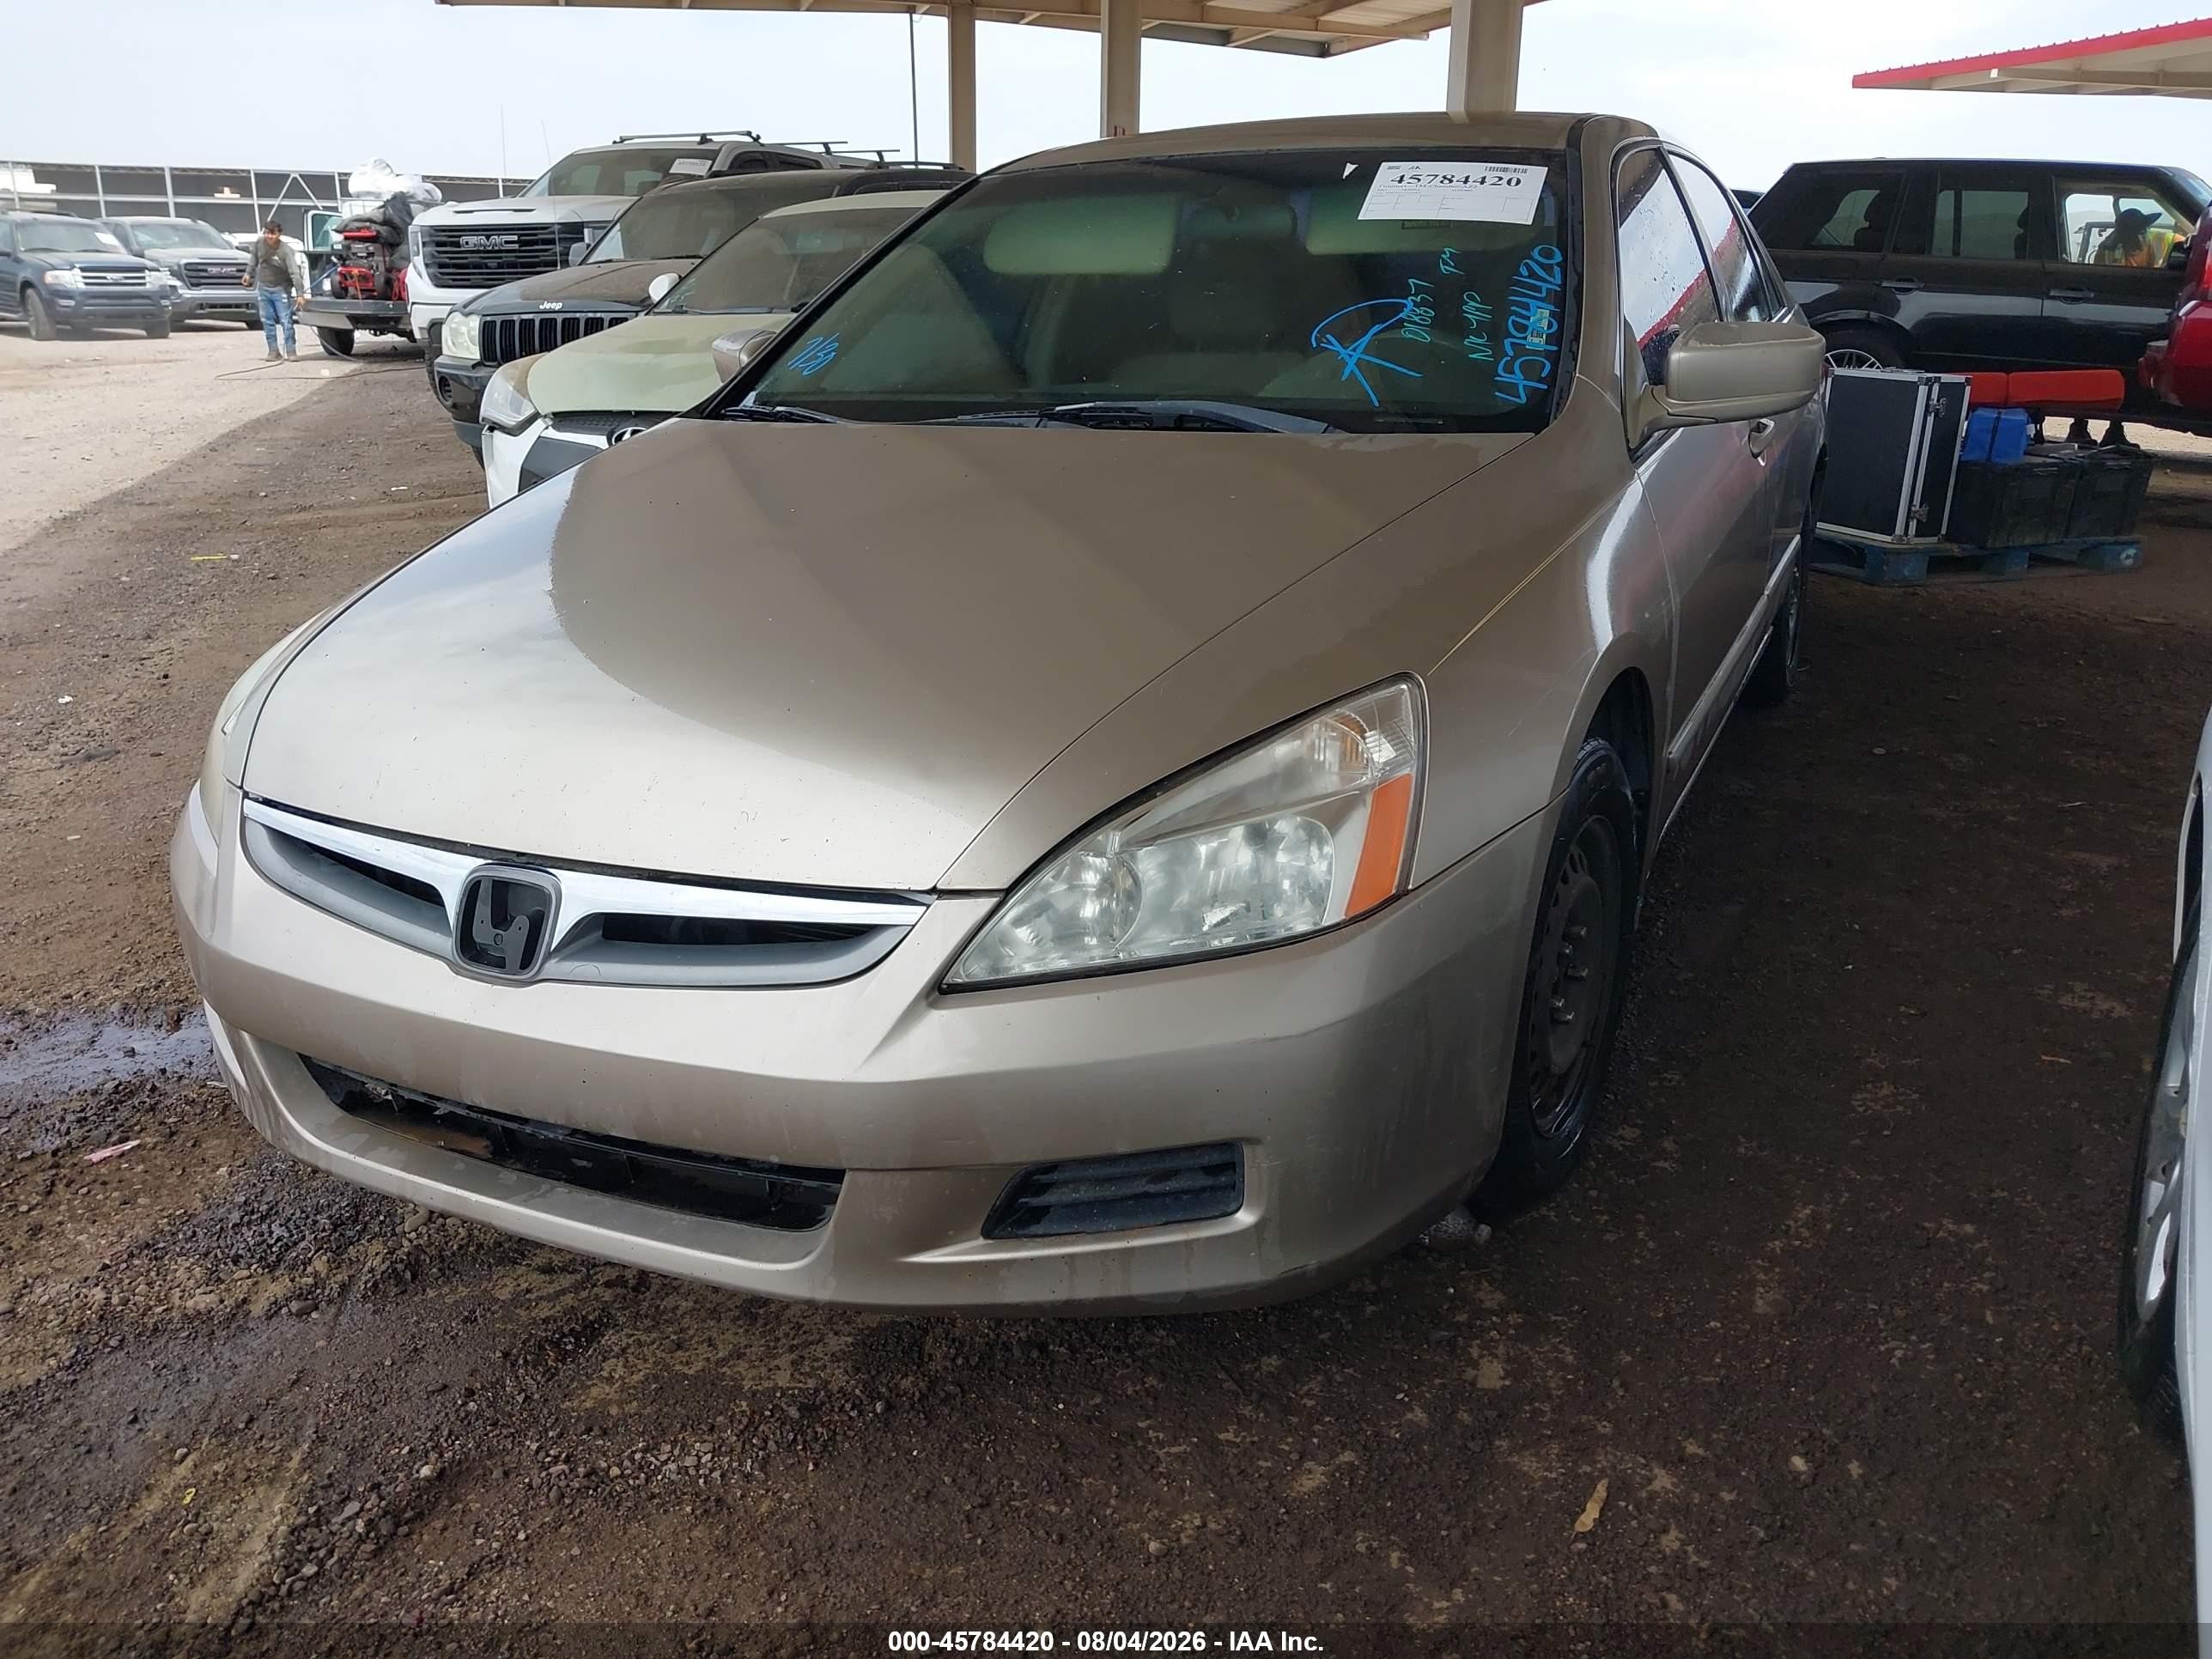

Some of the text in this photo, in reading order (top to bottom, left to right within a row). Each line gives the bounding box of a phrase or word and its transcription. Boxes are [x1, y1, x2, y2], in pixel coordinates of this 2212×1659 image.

[1389, 173, 1522, 188] 45784420
[459, 235, 519, 251] GMC
[539, 301, 563, 311] Jeep
[1494, 245, 1563, 404] 45784420
